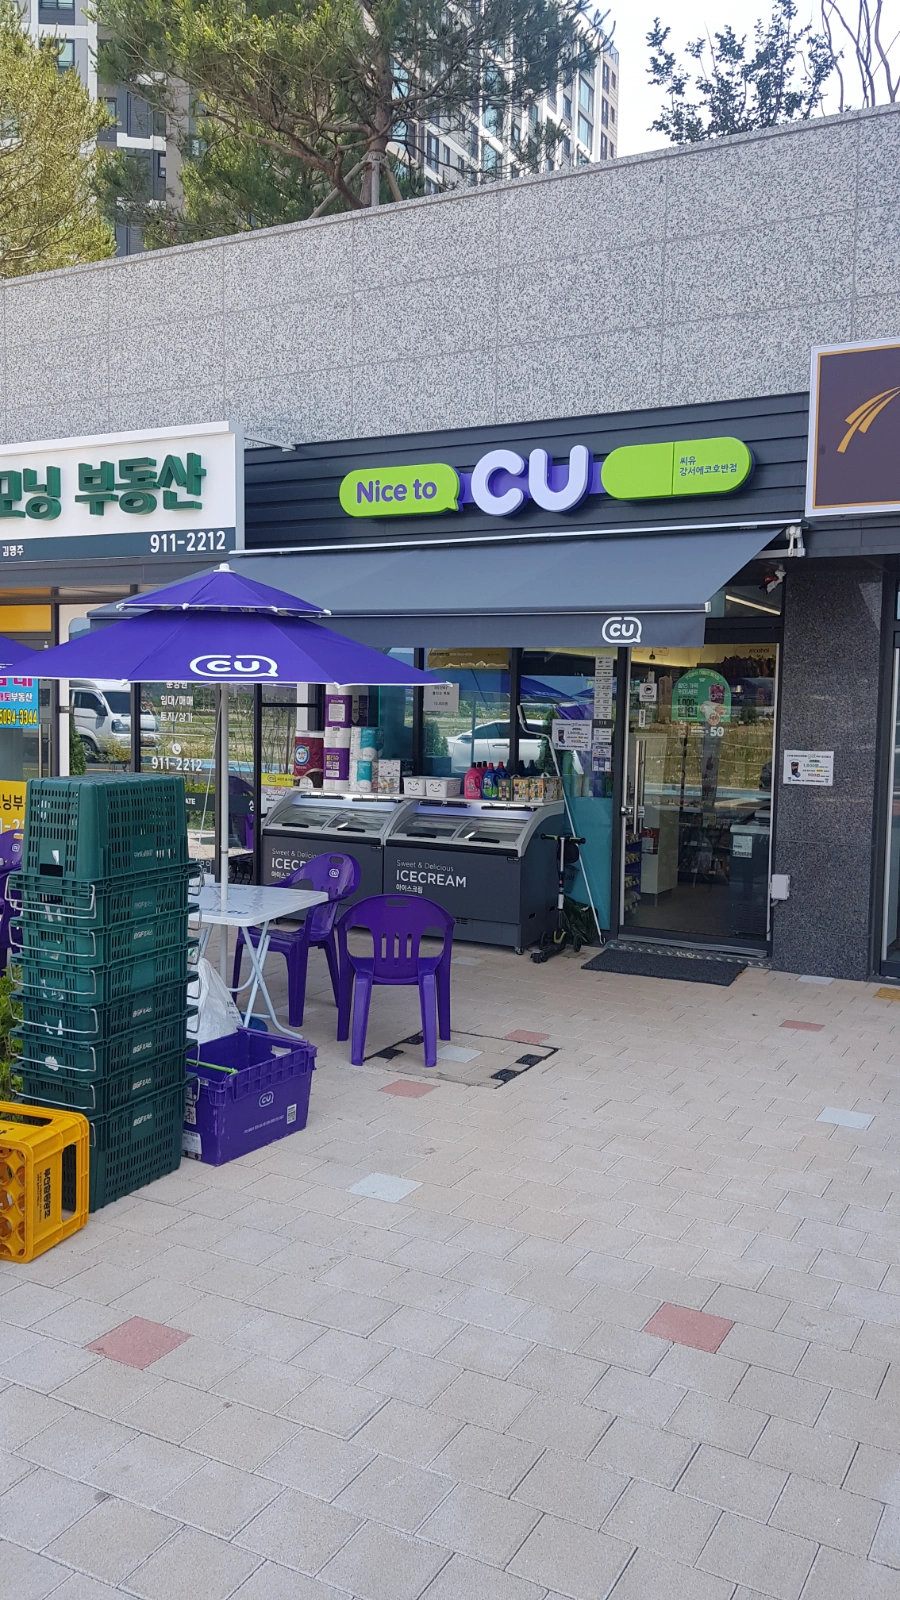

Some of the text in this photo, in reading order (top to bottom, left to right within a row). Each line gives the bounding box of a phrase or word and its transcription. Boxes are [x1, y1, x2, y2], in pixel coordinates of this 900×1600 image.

[680, 456, 696, 465] 씨유
[680, 463, 737, 476] 강서에코호반점
[75, 453, 207, 516] 부동산
[471, 445, 590, 517] CU
[357, 478, 437, 503] Nice to
[150, 530, 226, 553] 911-2212
[2, 545, 24, 557] 김명주
[161, 695, 193, 706] 임대/매매
[161, 711, 193, 723] 토지/상가
[710, 726, 724, 737] 50
[152, 756, 202, 772] 911-2212
[272, 848, 289, 856] Sweet
[397, 860, 416, 868] Sweet
[425, 863, 454, 872] Delicious
[396, 869, 467, 888] ICECREAM
[396, 884, 423, 893] 아이스크림
